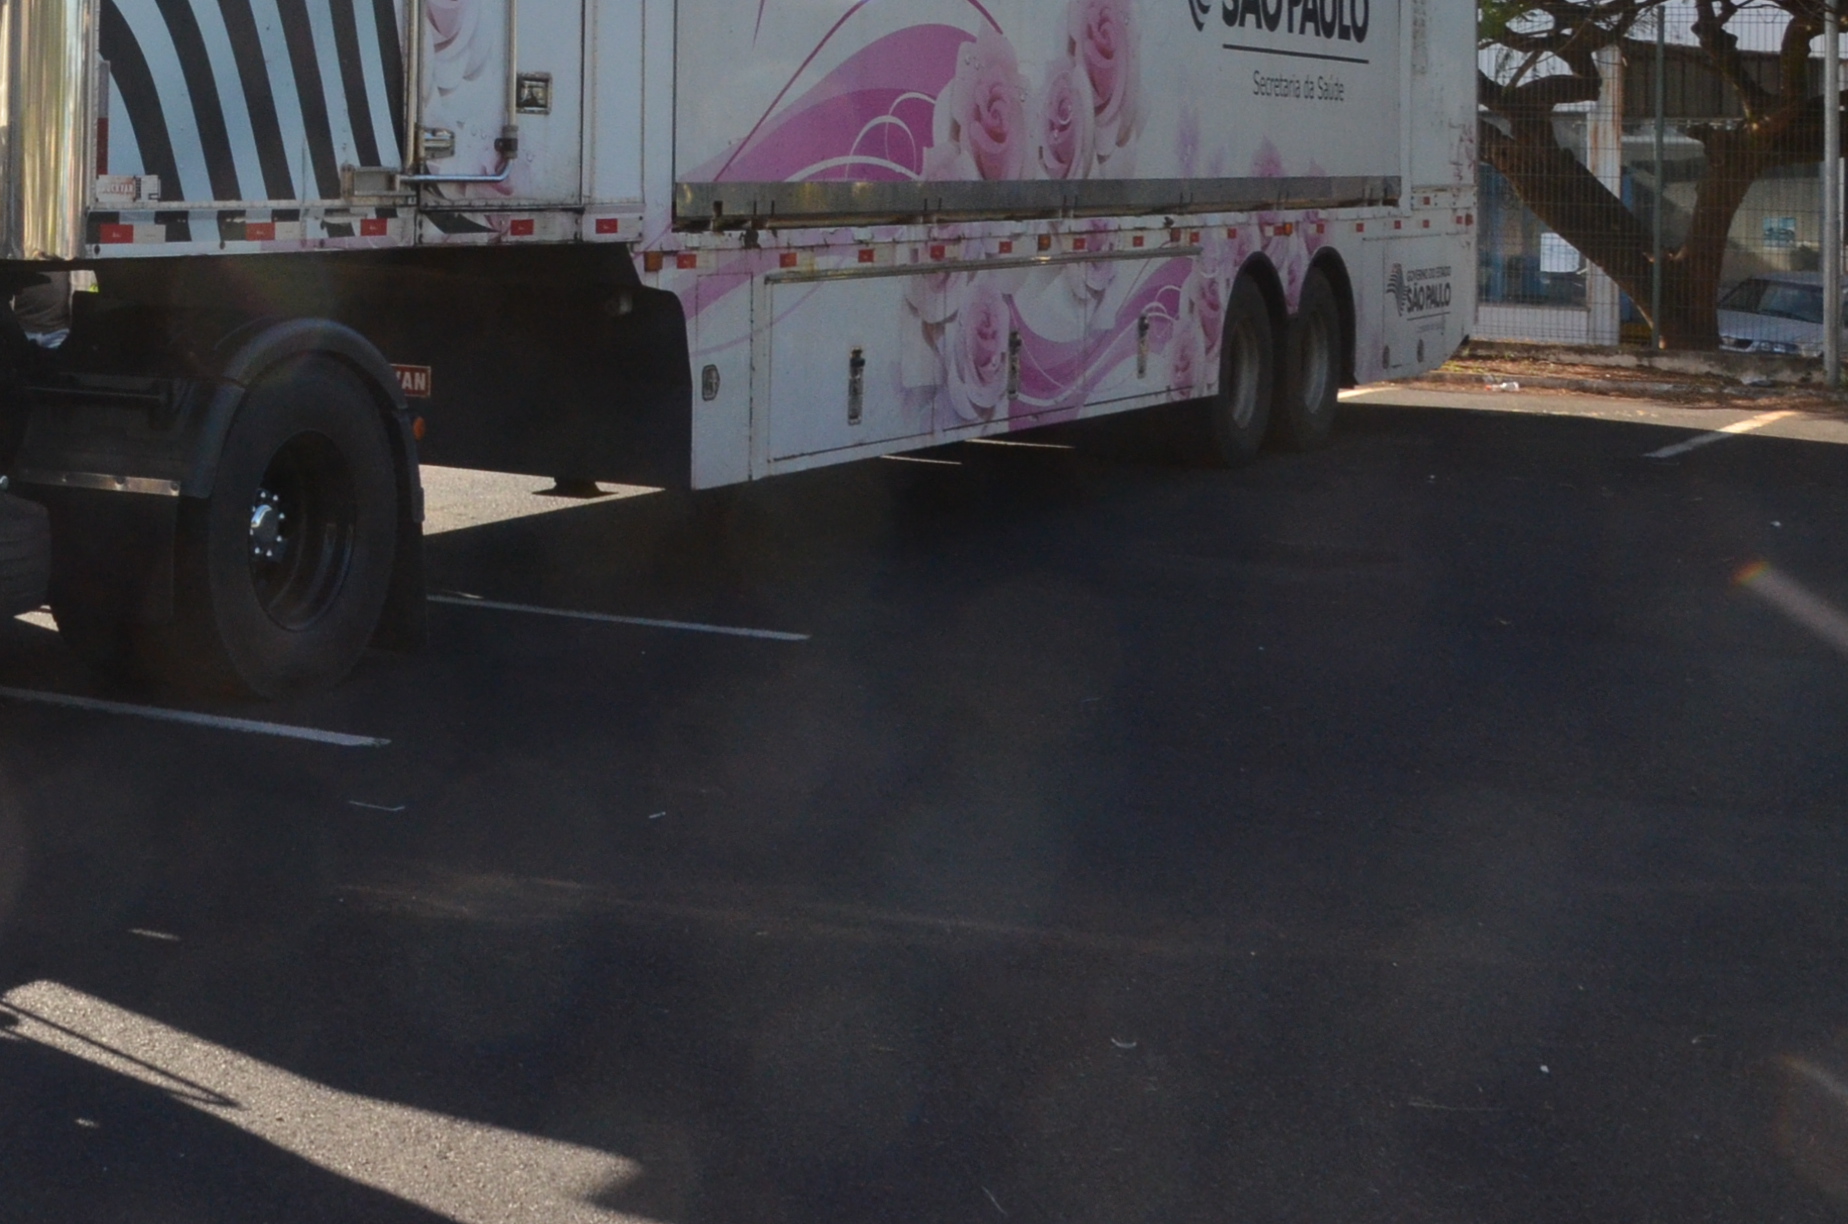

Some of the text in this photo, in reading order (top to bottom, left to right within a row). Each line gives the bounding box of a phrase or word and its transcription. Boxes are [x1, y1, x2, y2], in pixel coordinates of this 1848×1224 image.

[1253, 70, 1345, 102] Secretaria da Saúde
[1407, 282, 1451, 314] SÃO PAULO
